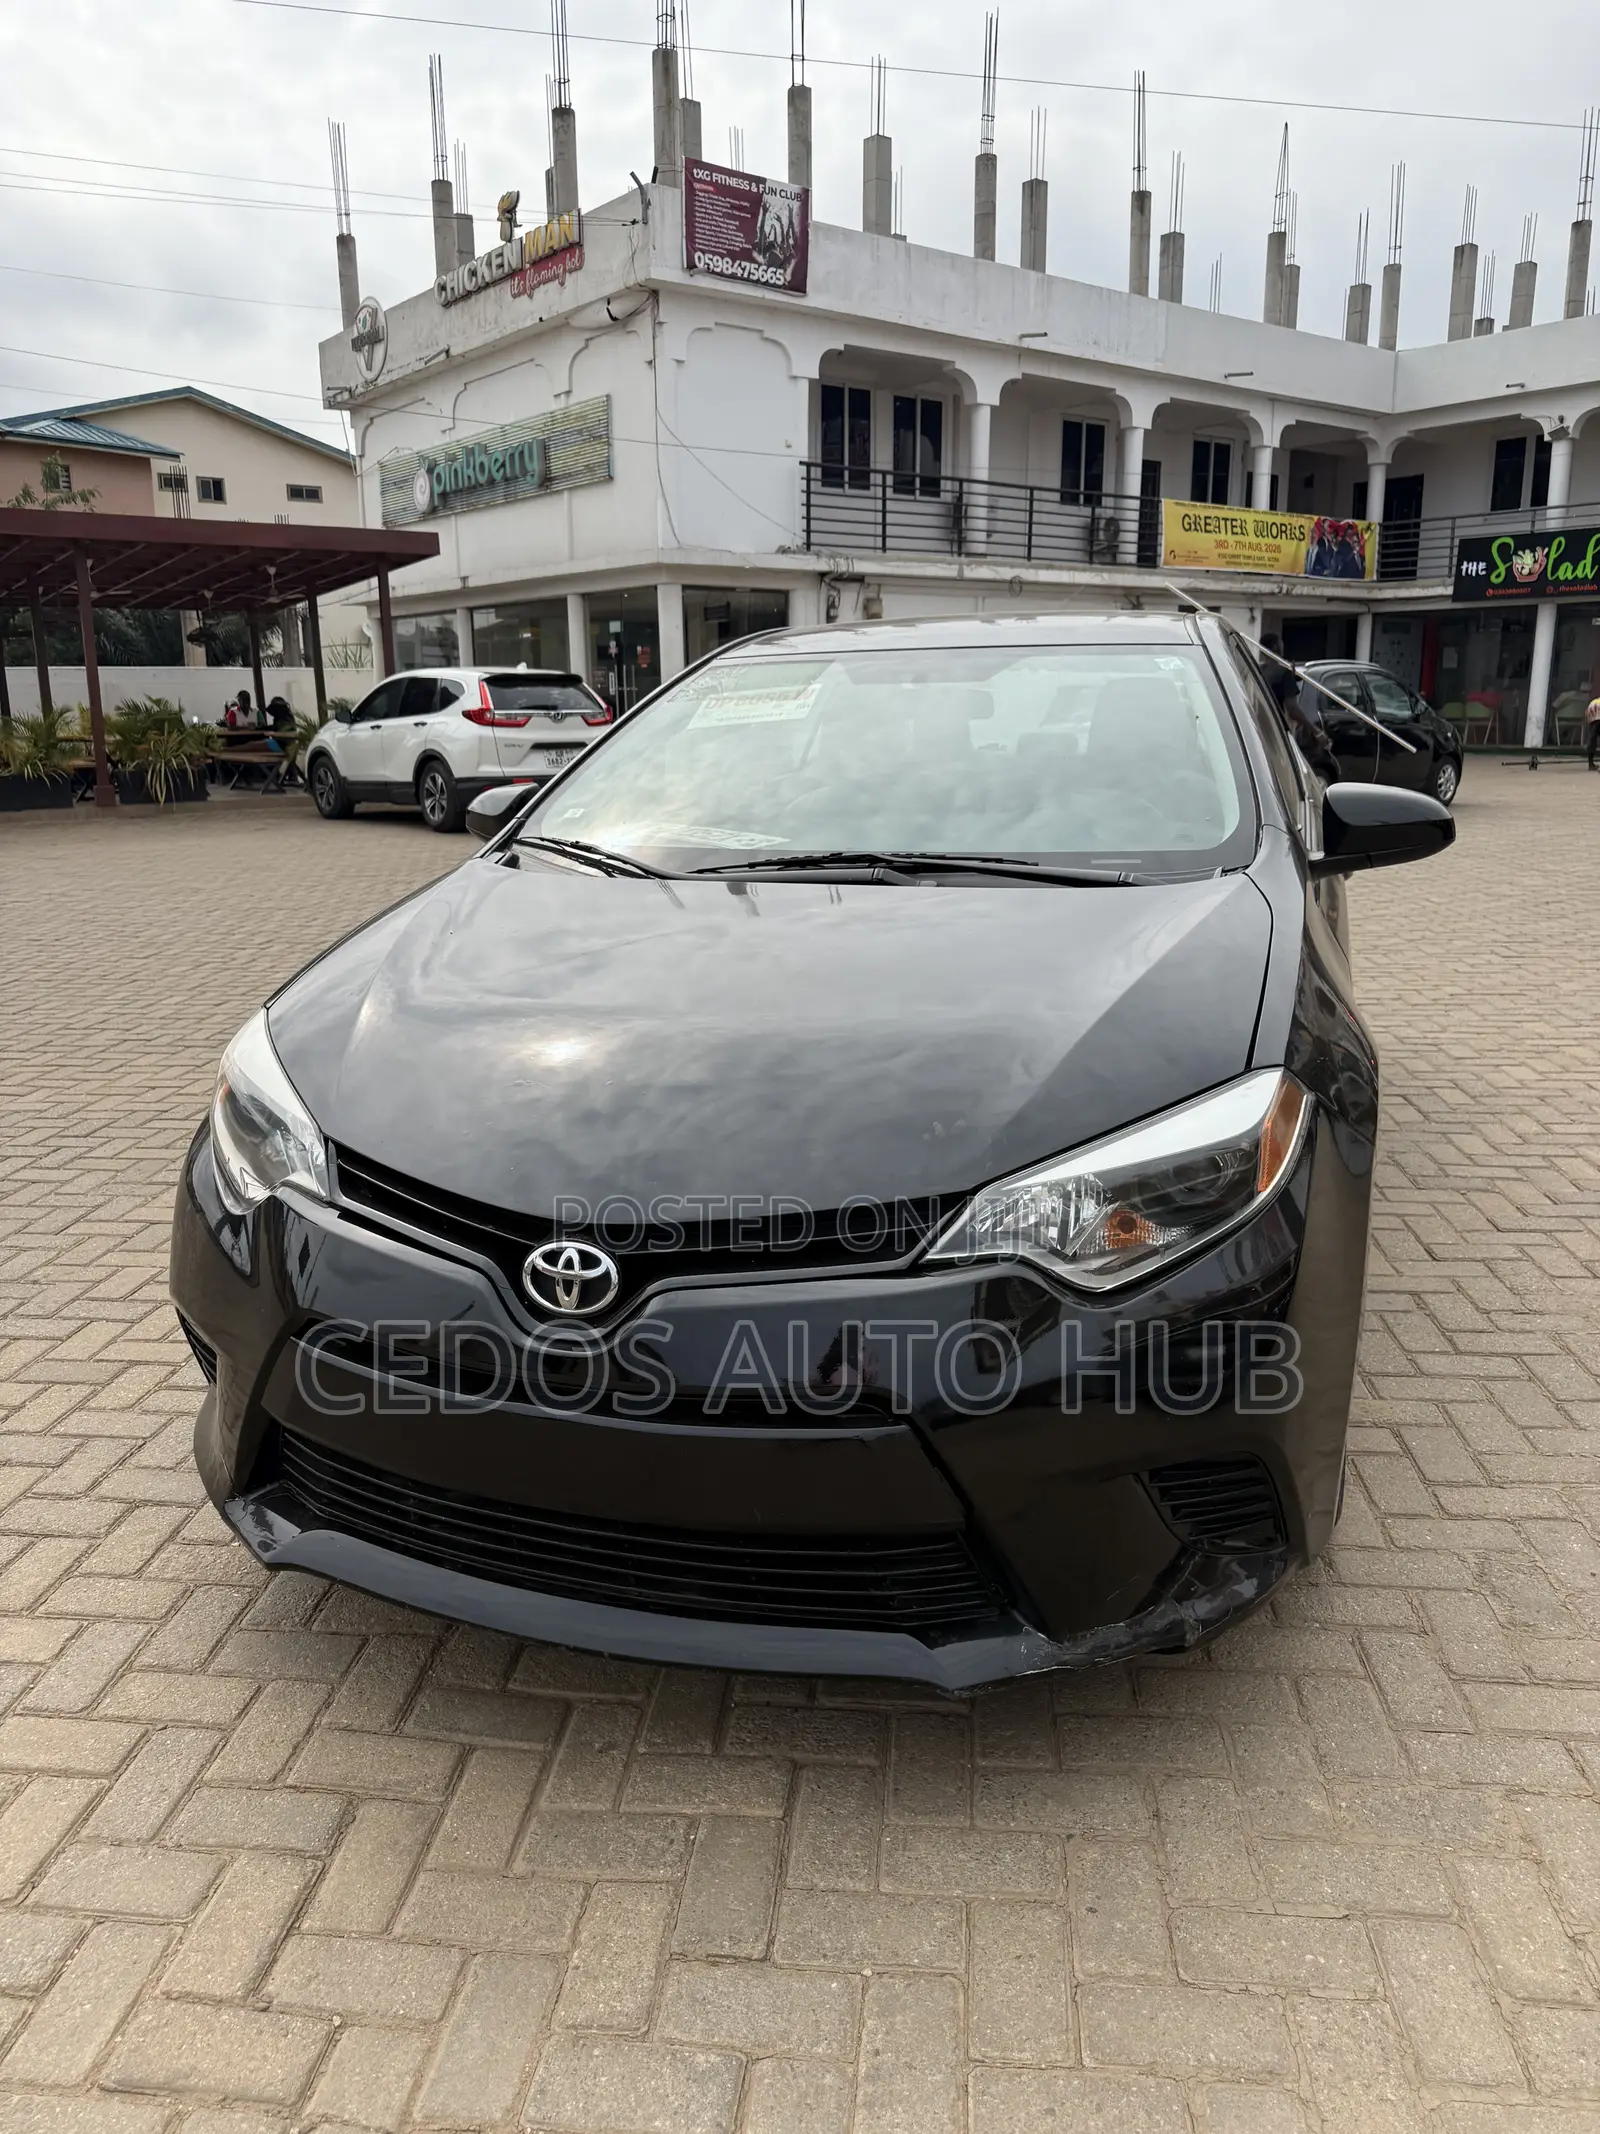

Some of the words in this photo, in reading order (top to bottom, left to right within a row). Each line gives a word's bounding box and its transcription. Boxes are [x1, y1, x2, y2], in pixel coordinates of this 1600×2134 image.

[712, 174, 750, 191] FITNESS
[751, 183, 758, 192] &
[759, 185, 777, 197] FUN
[779, 189, 802, 202] CLUB
[434, 238, 522, 307] CHICKEN
[525, 209, 581, 263] MAN
[694, 251, 785, 285] 0598475665
[525, 263, 563, 295] flaming
[433, 439, 544, 507] pinkberry
[1182, 513, 1248, 536] GREATER
[1254, 520, 1305, 542] WORKS
[1234, 540, 1247, 551] 7TH
